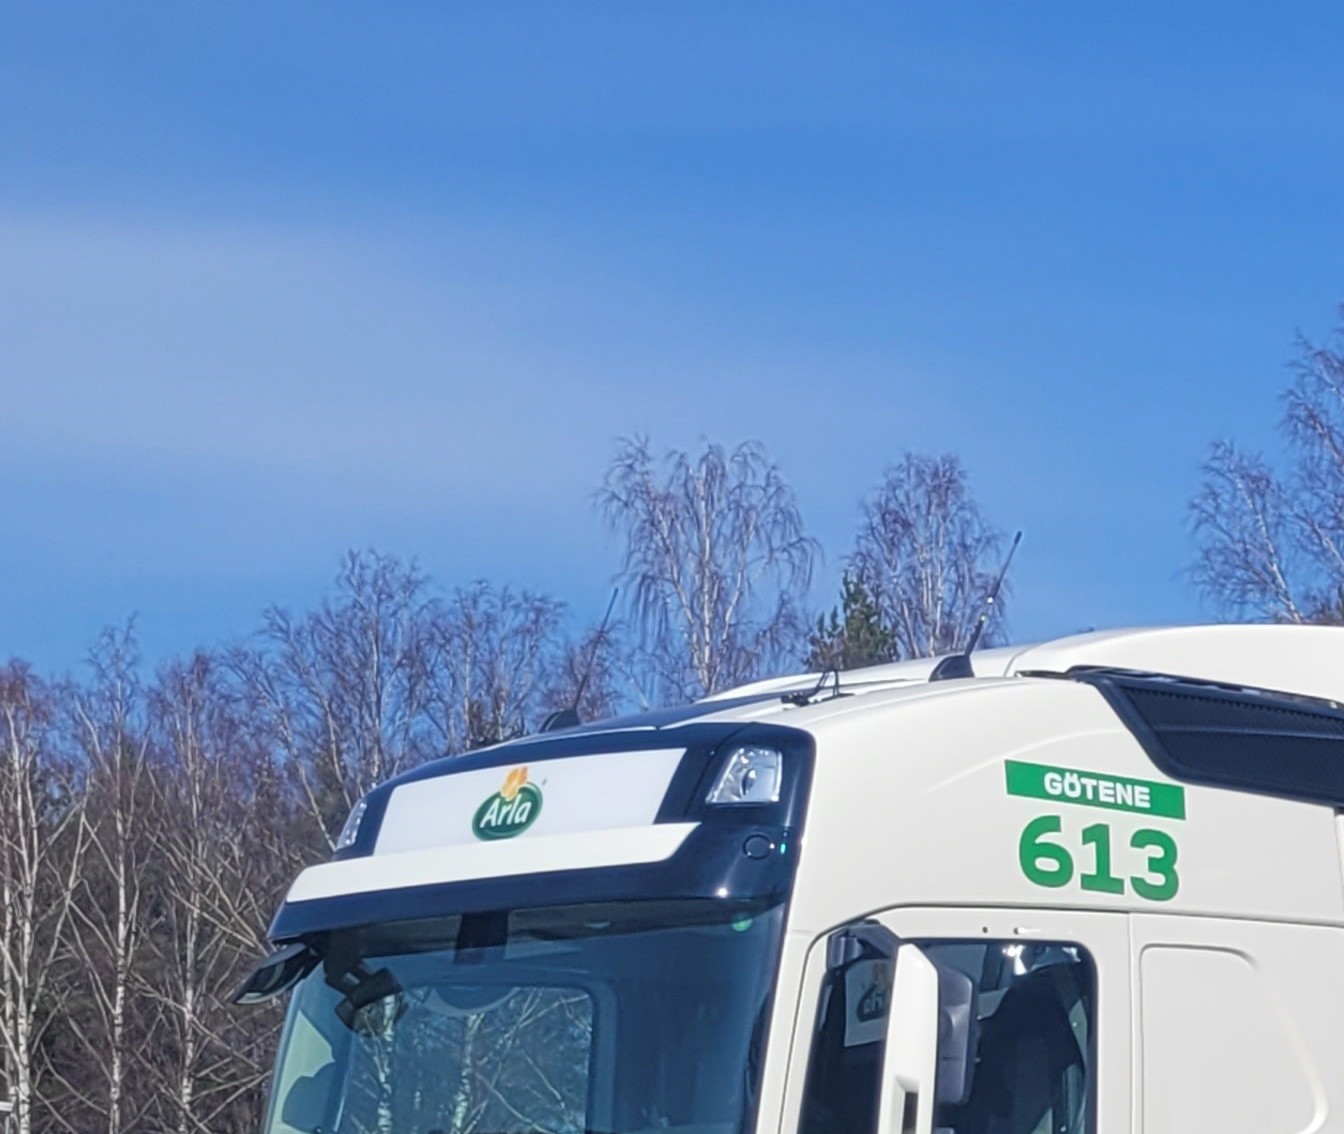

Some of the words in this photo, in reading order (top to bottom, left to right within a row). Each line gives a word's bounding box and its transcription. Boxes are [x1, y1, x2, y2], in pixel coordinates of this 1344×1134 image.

[1043, 771, 1151, 809] GÖTENE
[479, 793, 533, 829] Arla
[1018, 815, 1180, 902] 613
